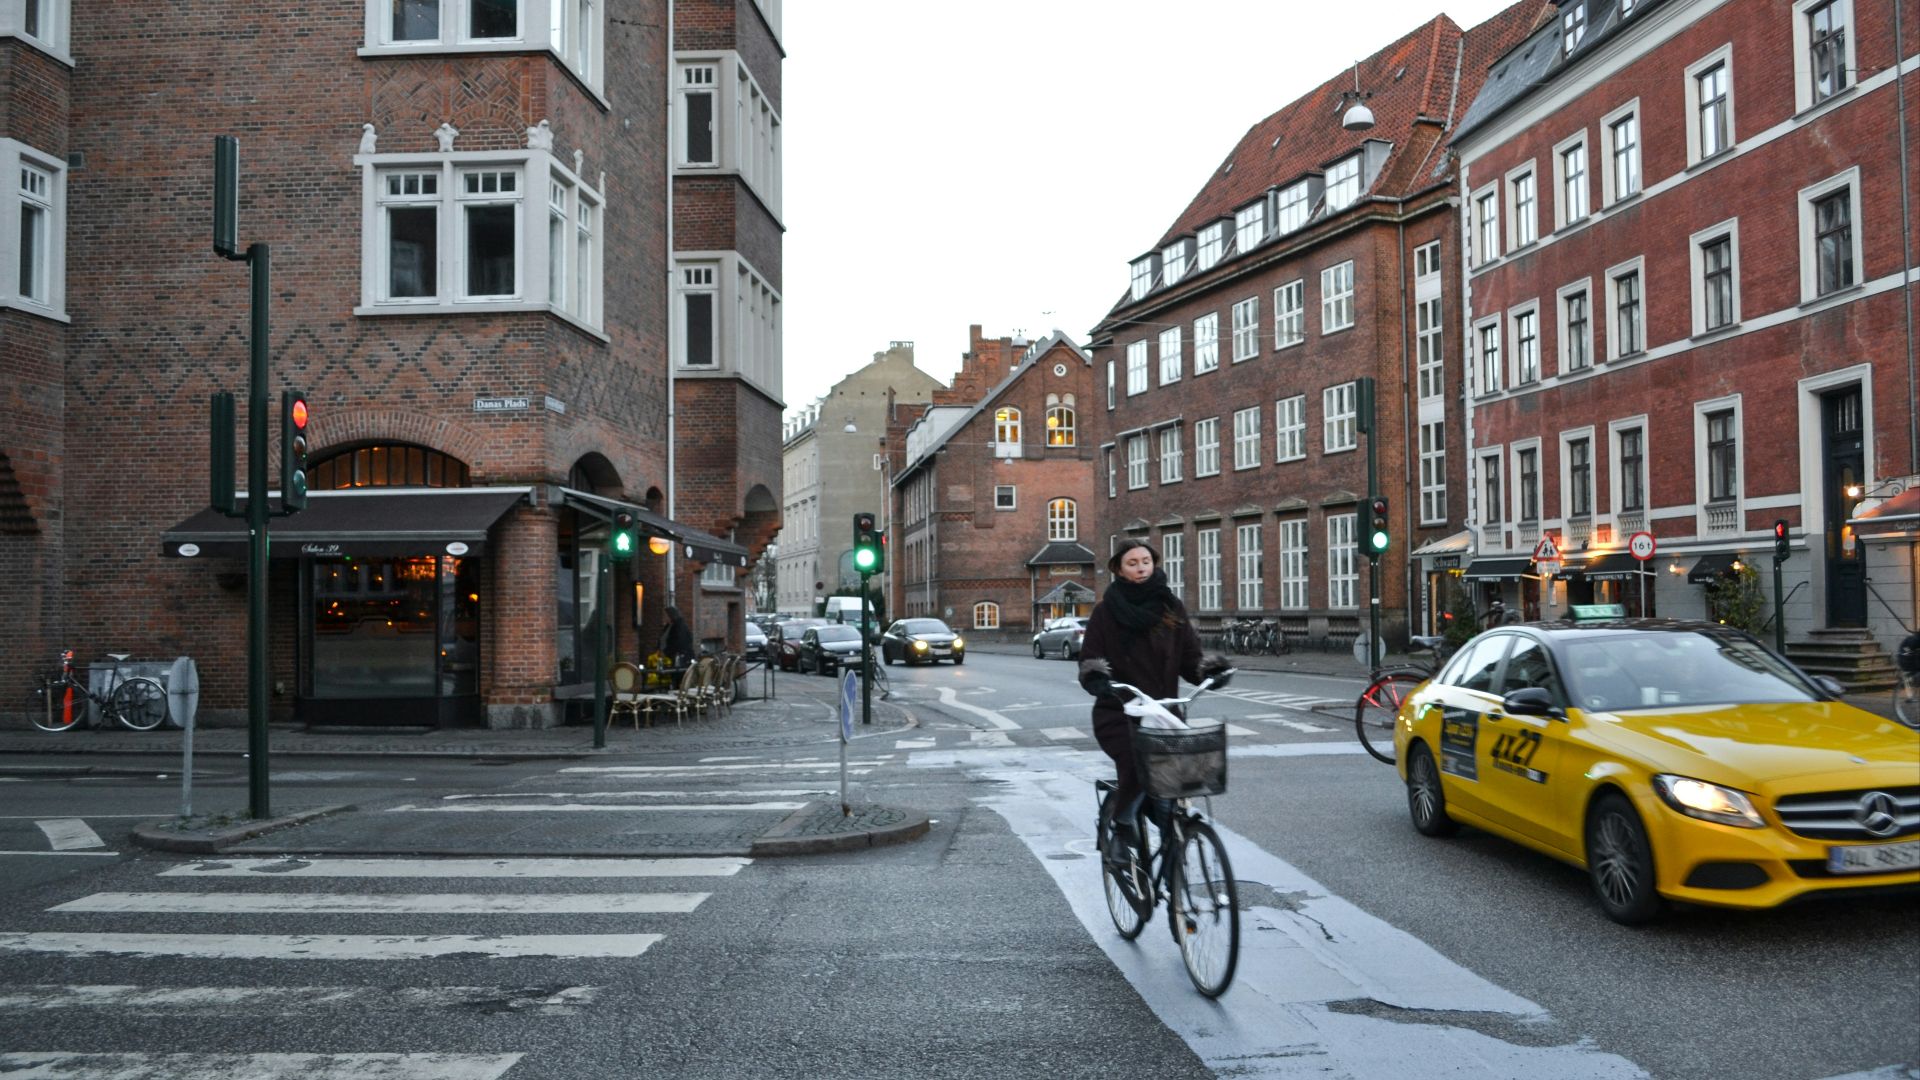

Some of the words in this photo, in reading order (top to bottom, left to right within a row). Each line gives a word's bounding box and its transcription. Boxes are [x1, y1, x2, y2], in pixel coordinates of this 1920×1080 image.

[477, 400, 502, 409] Danas
[504, 399, 526, 409] Plads
[1634, 542, 1645, 550] 16
[1647, 542, 1651, 550] t
